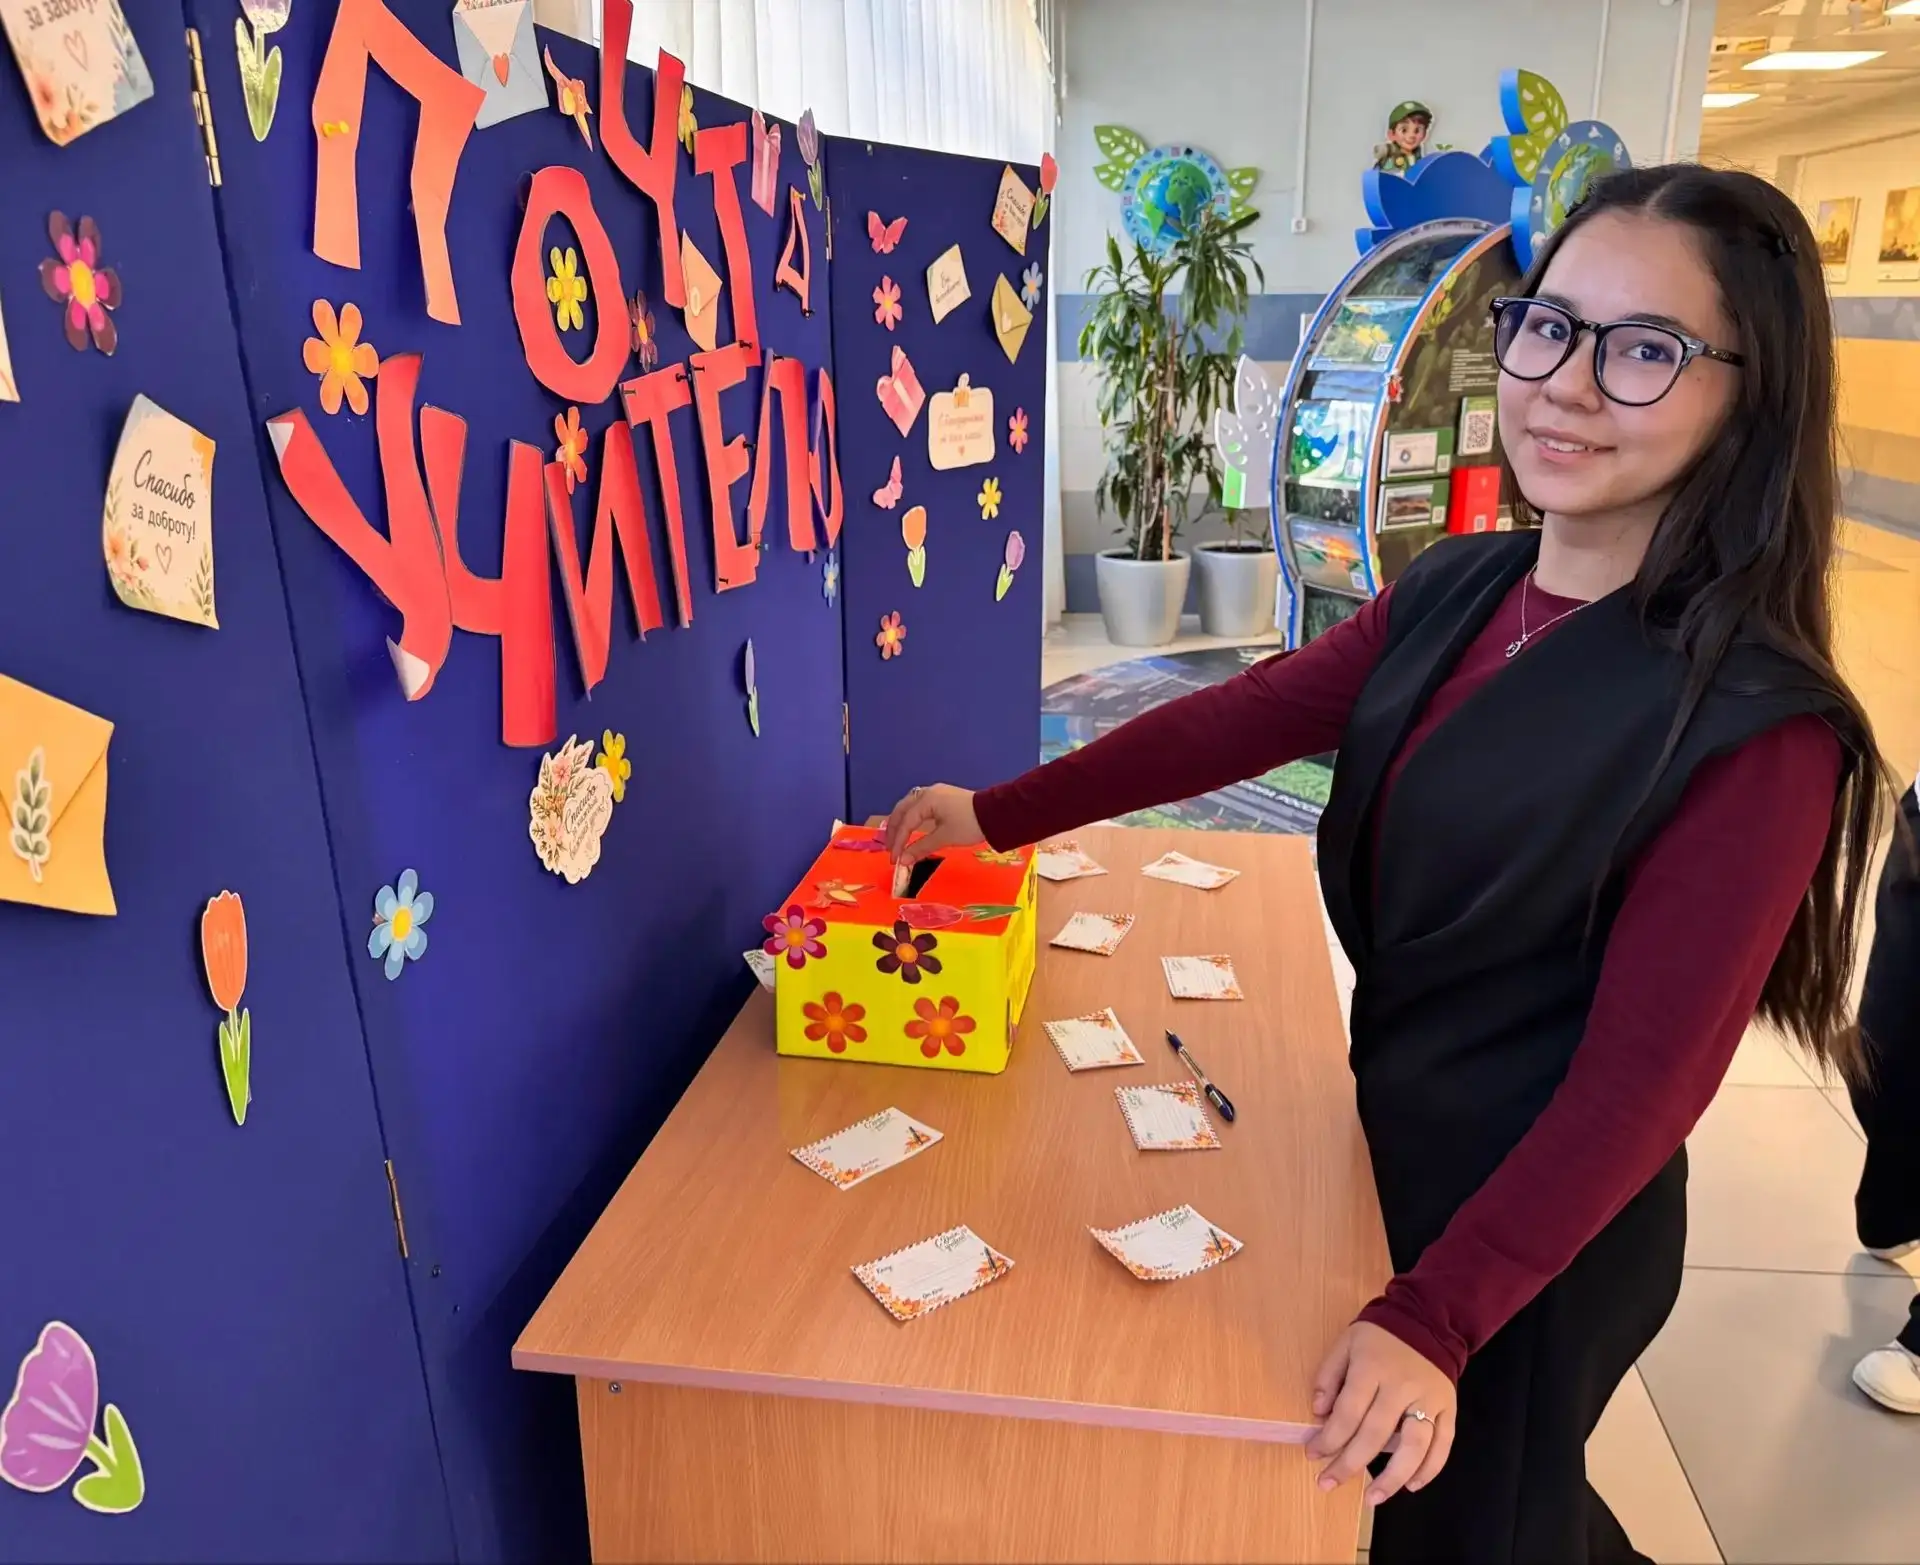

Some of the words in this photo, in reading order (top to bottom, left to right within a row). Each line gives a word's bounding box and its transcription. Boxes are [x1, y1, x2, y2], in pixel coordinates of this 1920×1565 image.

[24, 5, 44, 30] за
[312, 0, 811, 404] ПОЧТА
[133, 449, 196, 509] Спасибо
[131, 502, 145, 521] за
[147, 510, 196, 544] доброту!
[266, 349, 844, 748] УЧИТЕЛЮ
[565, 783, 598, 834] Спасибо
